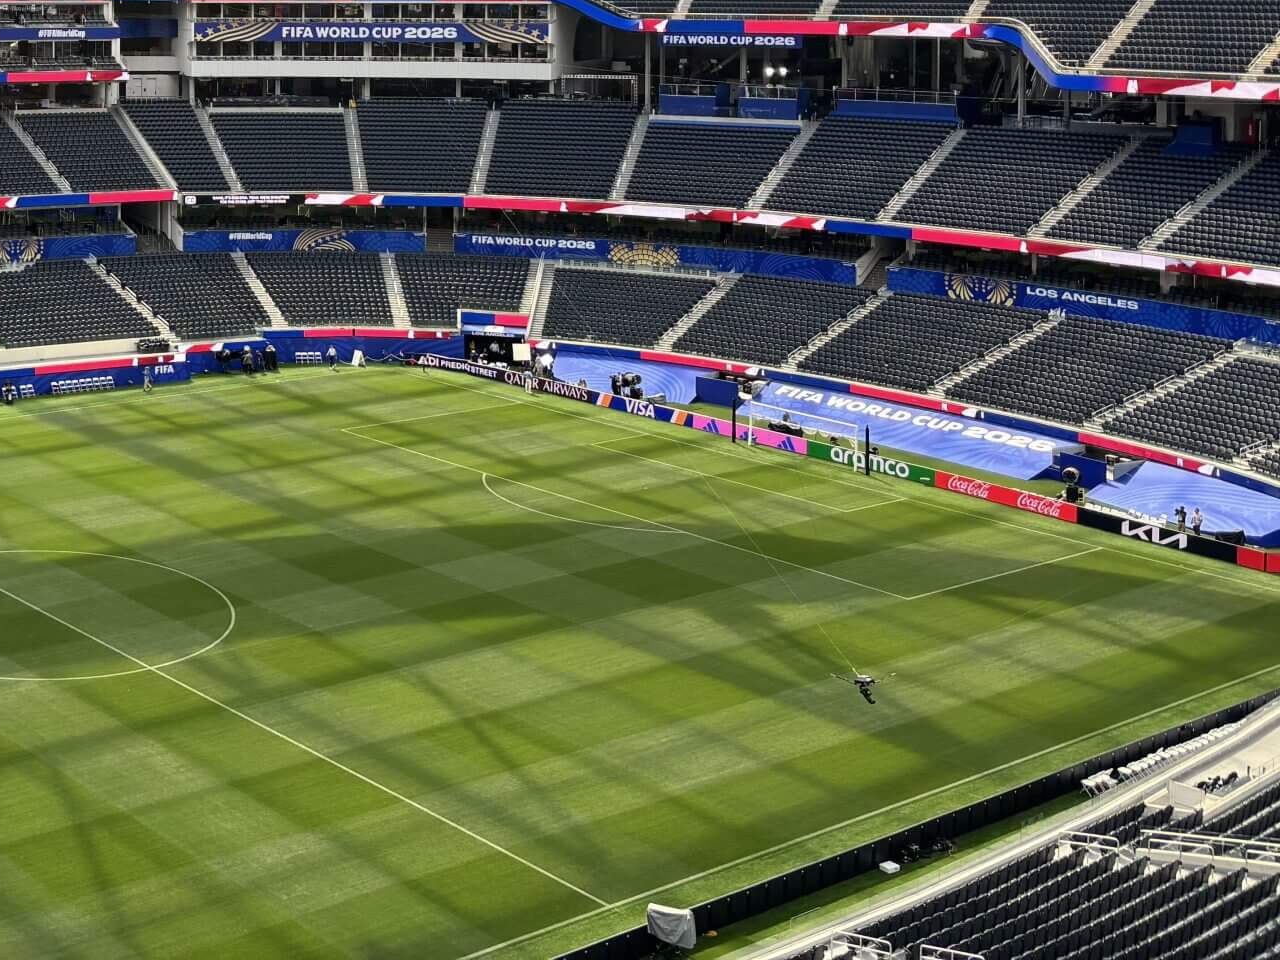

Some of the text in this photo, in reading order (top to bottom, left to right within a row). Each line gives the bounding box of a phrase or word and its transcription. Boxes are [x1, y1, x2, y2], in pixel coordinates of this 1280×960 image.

[282, 26, 458, 39] FIFA WORLD CUP 2026
[663, 35, 796, 46] FIFA WORLD CUP 2026
[471, 235, 596, 250] FIFA WORLD CUP 2026
[1026, 286, 1139, 310] LOS ANGELES
[154, 364, 175, 376] FIFA
[504, 372, 588, 401] QATR AIRWAYS
[624, 399, 656, 418] VISA
[775, 385, 1057, 452] FIFA WORLD CUP 2026
[830, 446, 910, 478] aramco
